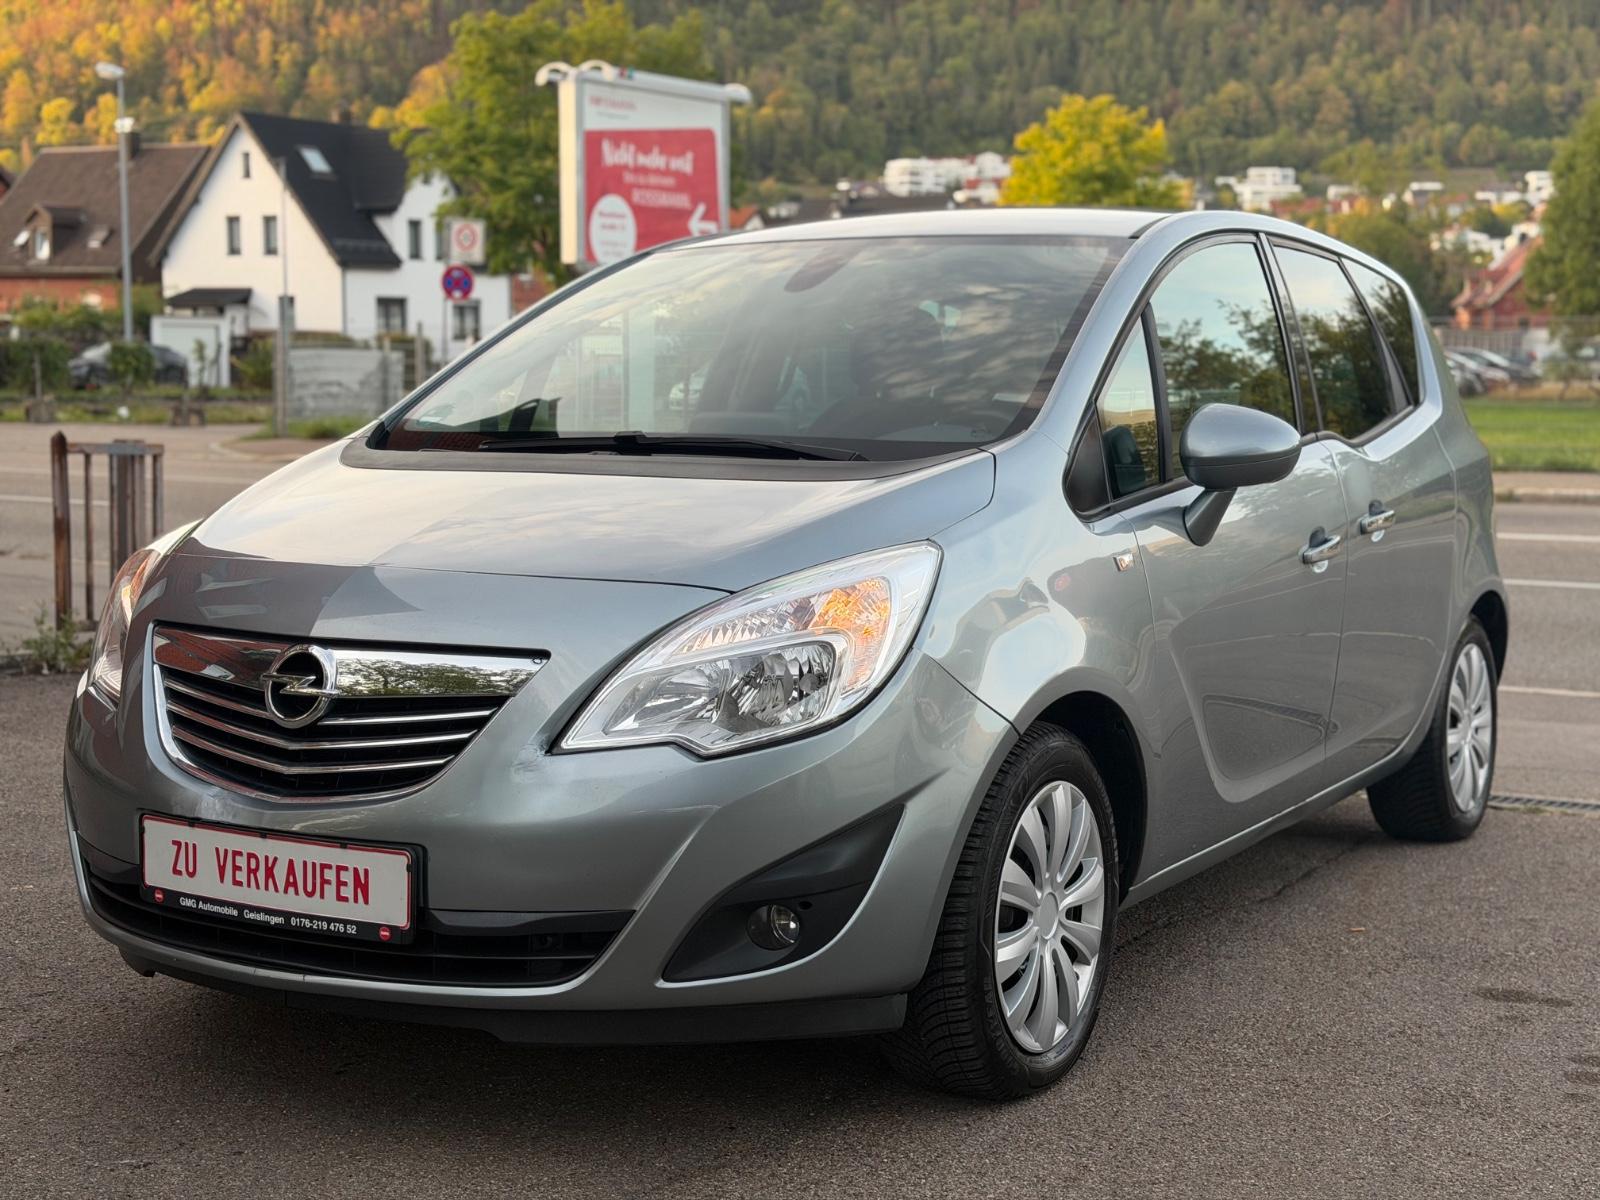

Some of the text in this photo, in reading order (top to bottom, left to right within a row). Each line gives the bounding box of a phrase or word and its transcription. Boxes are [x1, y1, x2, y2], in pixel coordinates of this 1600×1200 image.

[171, 839, 370, 905] ZU VERKAUFEN
[179, 897, 357, 934] GMG Automobile Geislingen 0176-219 476 52
